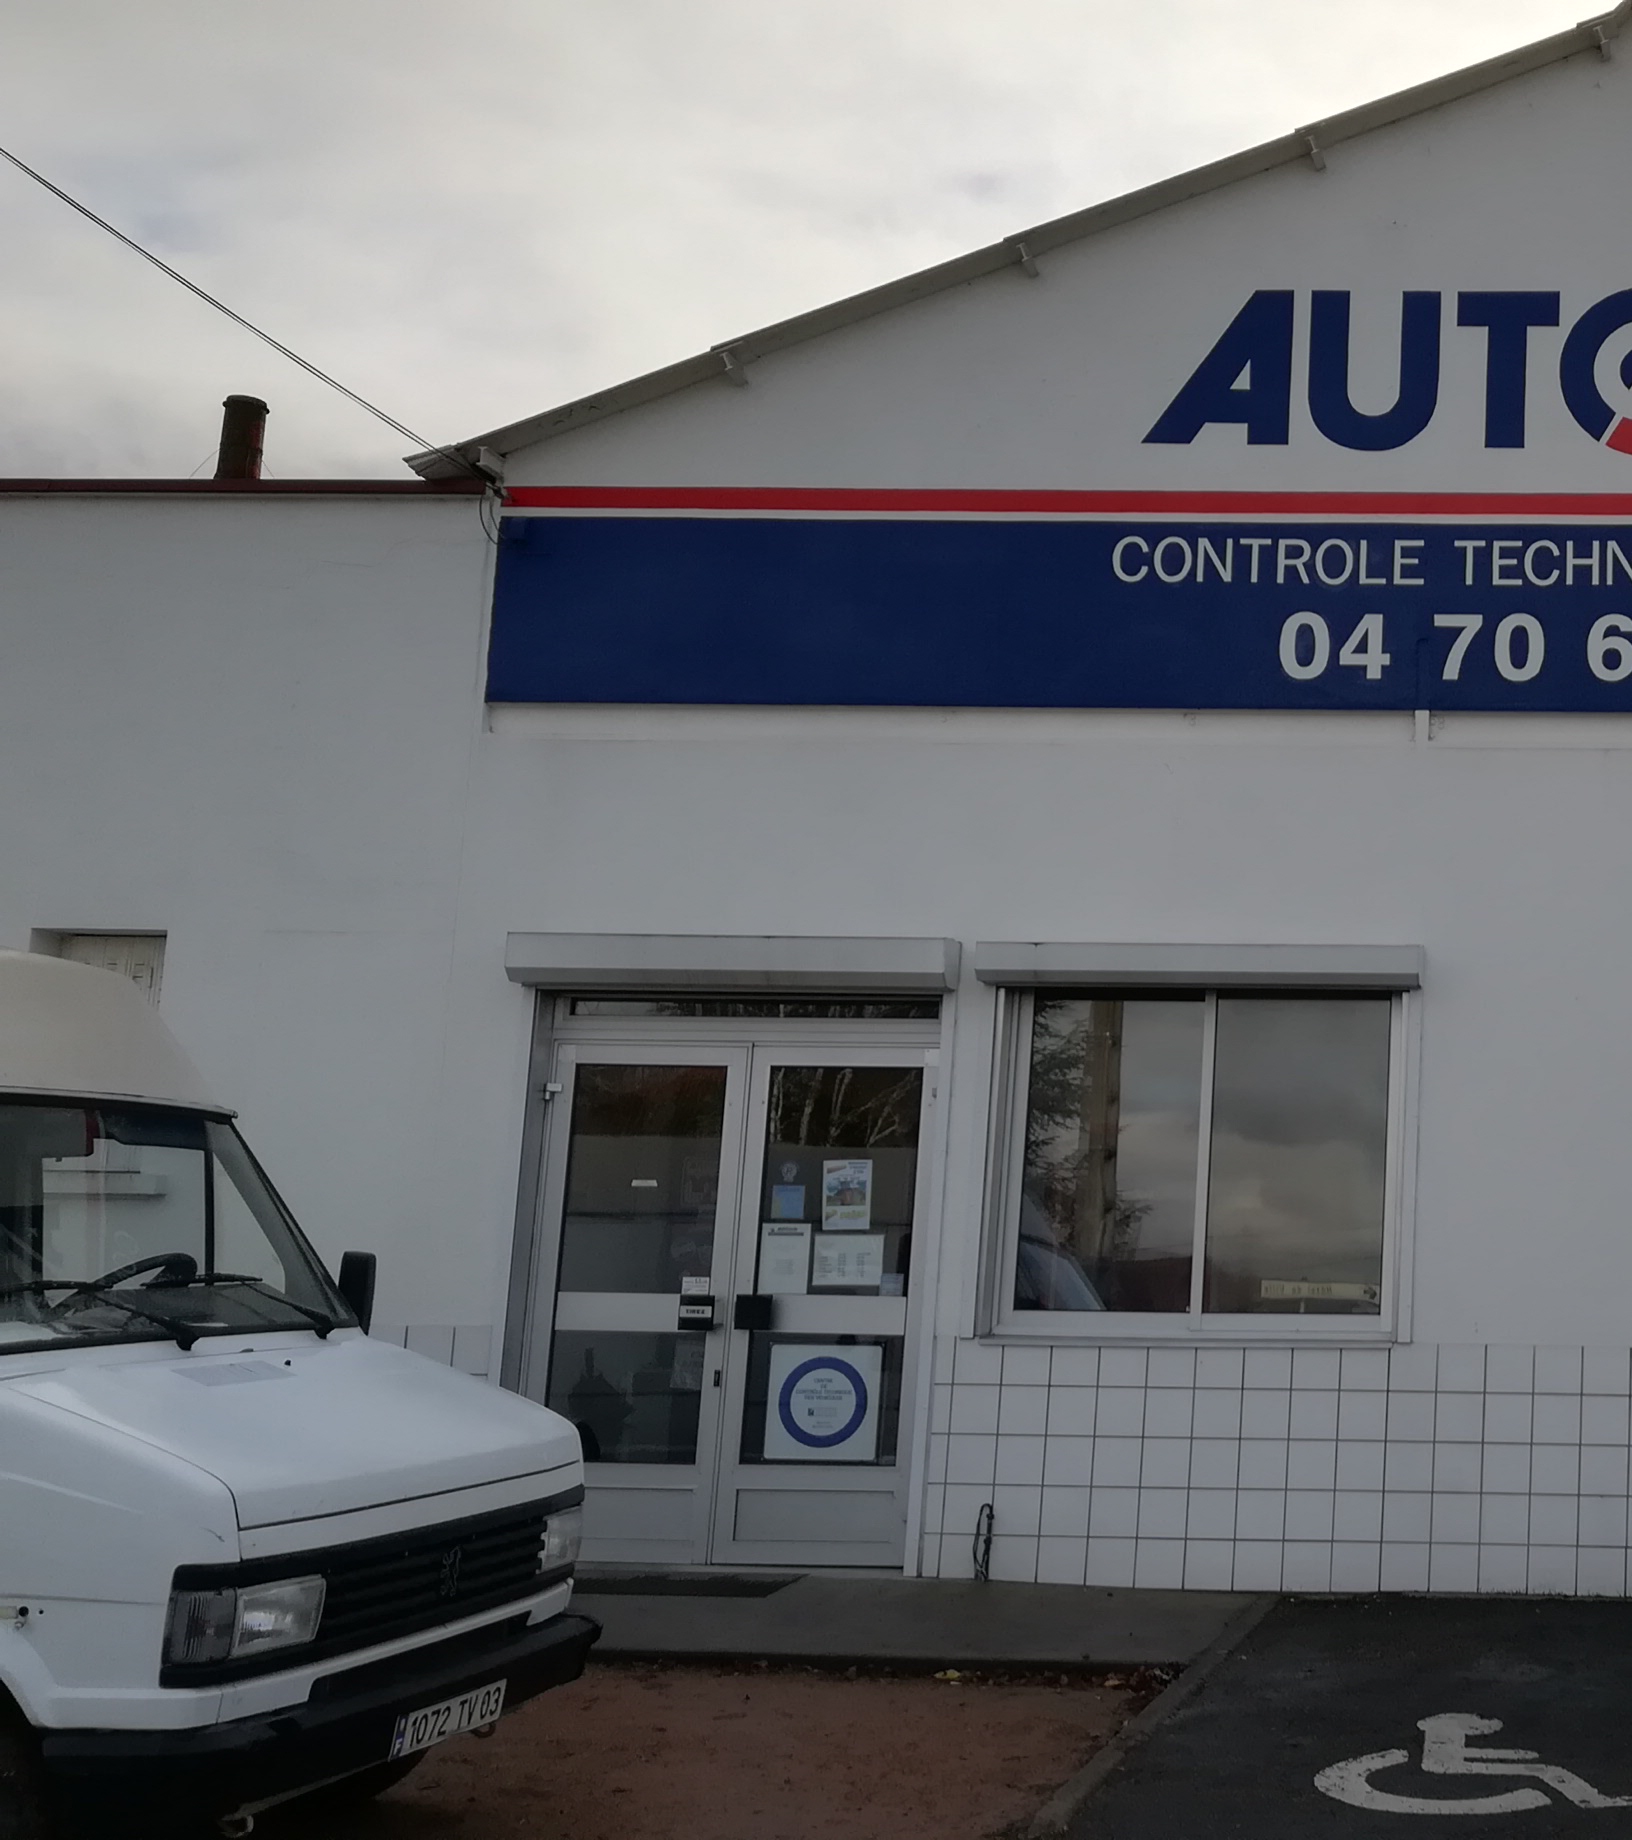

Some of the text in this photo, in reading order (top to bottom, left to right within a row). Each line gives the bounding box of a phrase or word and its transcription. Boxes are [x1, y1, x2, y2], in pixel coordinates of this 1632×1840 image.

[1111, 535, 1425, 586] CONTROLE
[1279, 611, 1391, 680] 04
[1433, 612, 1545, 682] 70
[409, 1686, 502, 1748] 1072 TV 03
[393, 1738, 404, 1756] F
